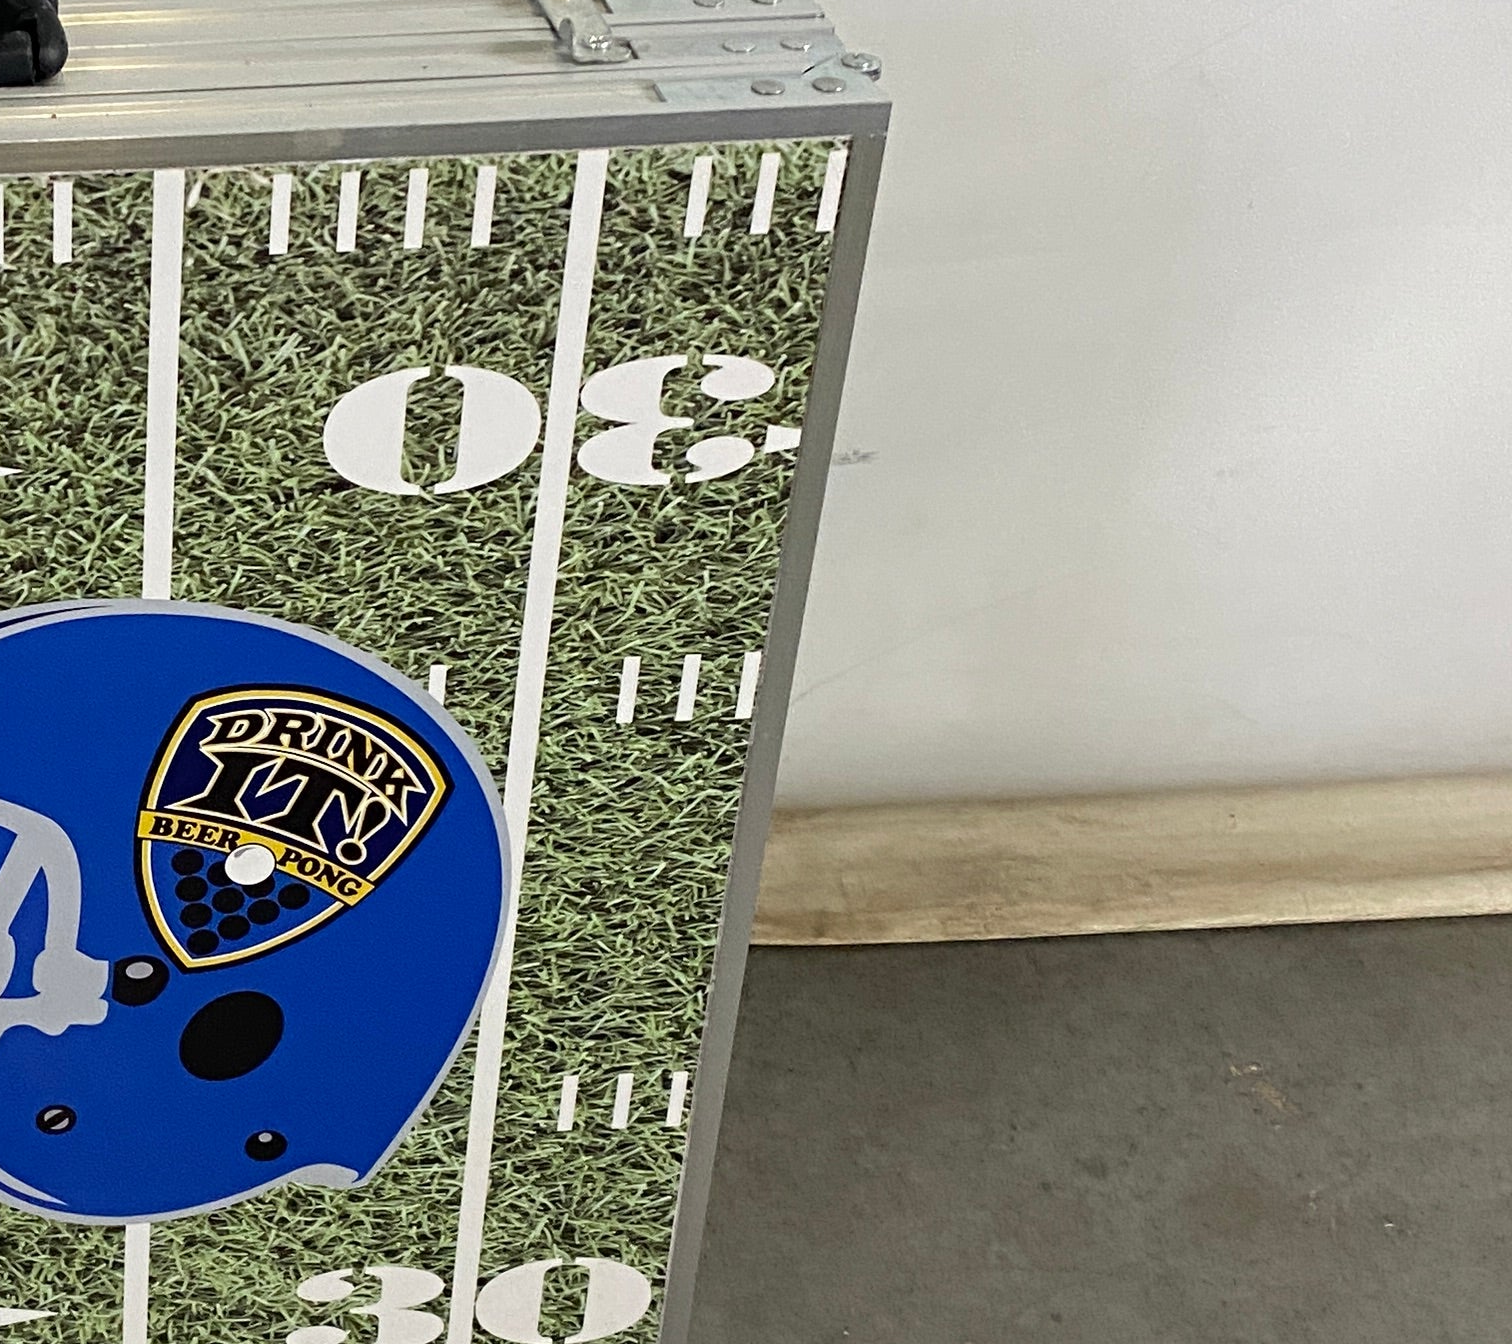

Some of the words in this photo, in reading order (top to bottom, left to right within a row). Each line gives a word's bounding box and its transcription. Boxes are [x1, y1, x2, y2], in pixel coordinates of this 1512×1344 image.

[163, 746, 392, 866] IT!
[199, 707, 427, 826] DRINK
[150, 814, 240, 851] BEER
[277, 846, 363, 897] PONG
